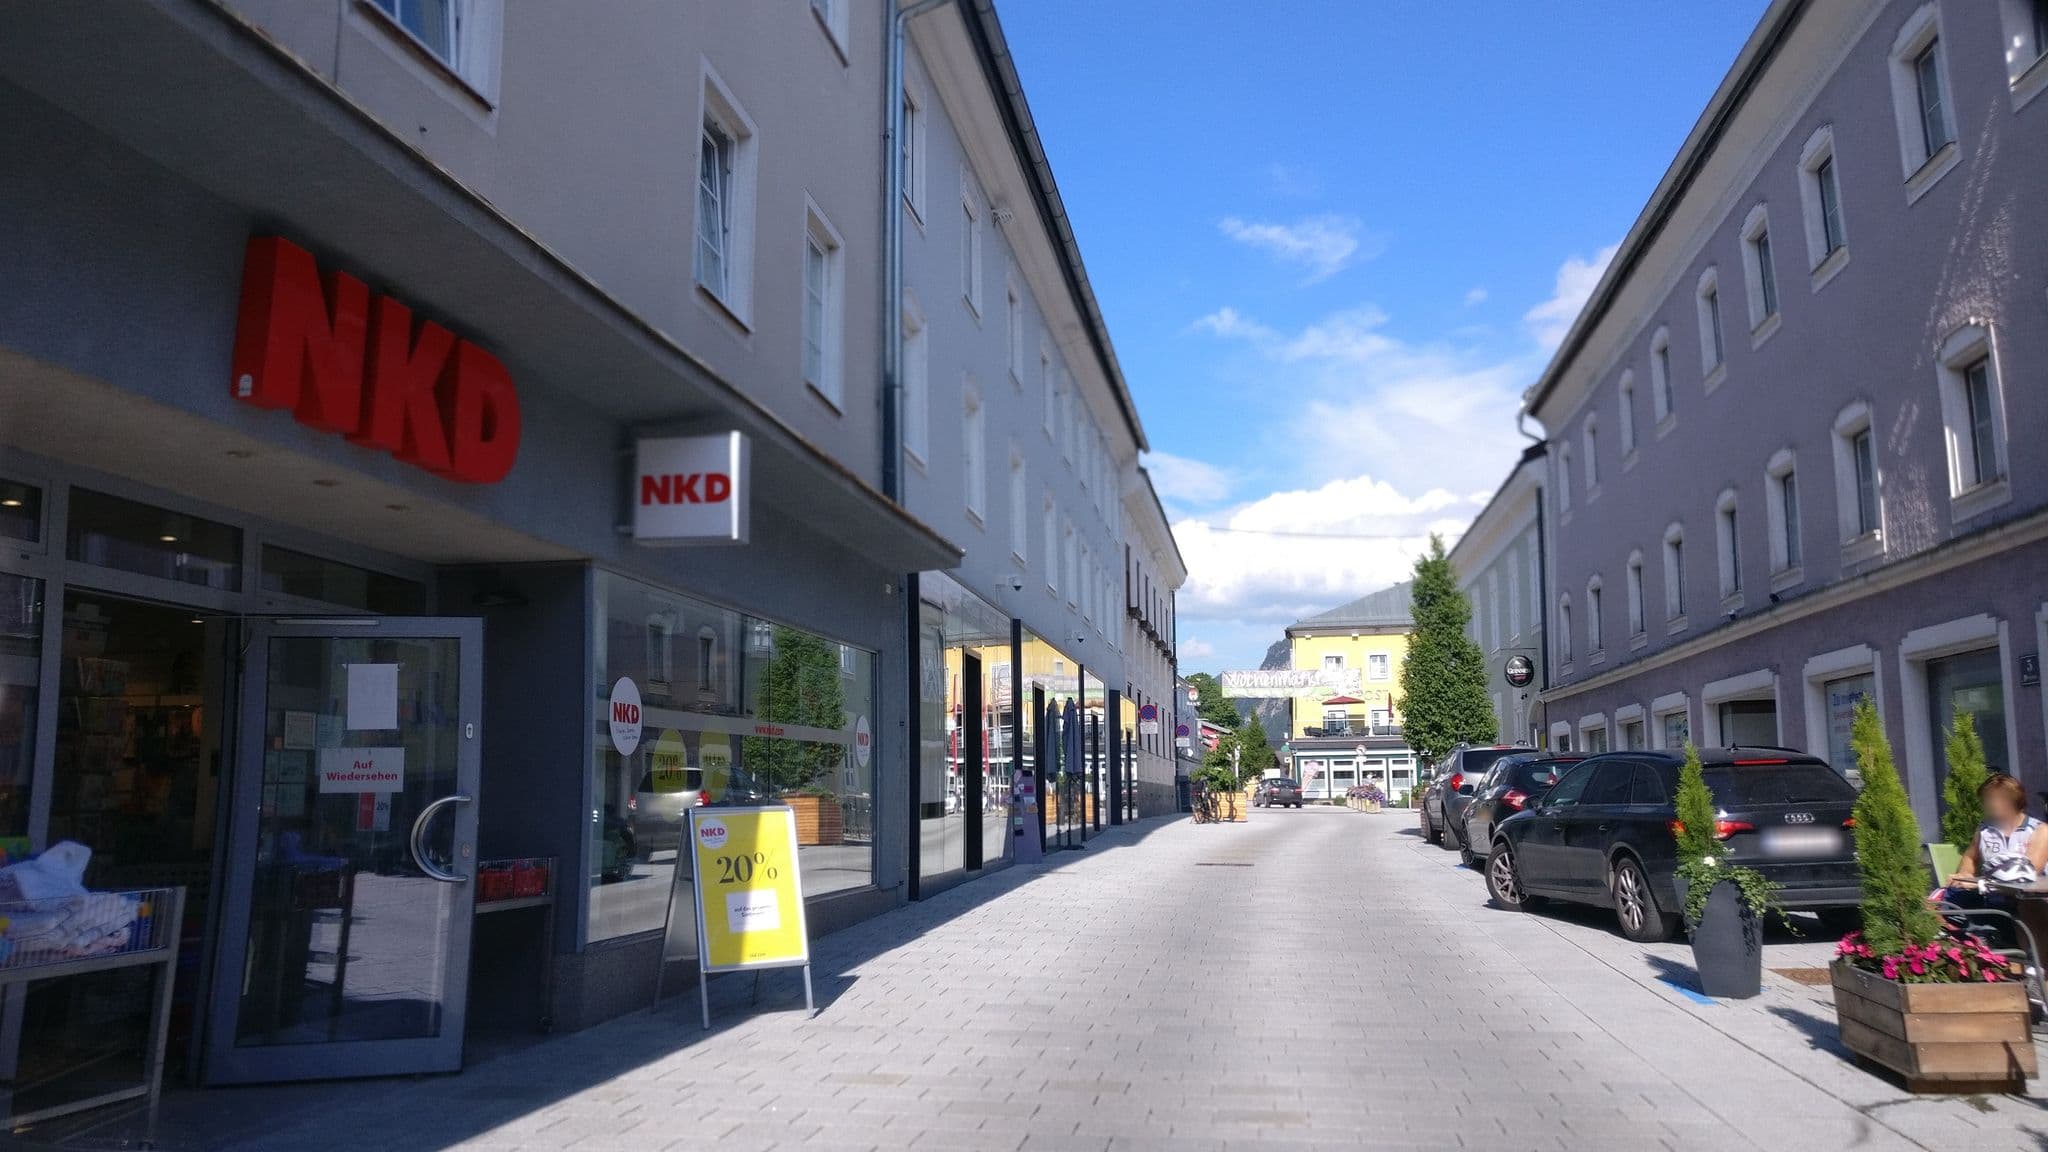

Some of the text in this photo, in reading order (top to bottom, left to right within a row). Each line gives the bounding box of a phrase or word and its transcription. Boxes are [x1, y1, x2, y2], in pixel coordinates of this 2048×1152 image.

[231, 236, 521, 484] NKD
[641, 473, 731, 506] NKD
[613, 702, 639, 724] NKD
[857, 732, 869, 747] NKD
[353, 760, 374, 770] Auf
[326, 771, 398, 782] Wiedersehen
[700, 827, 725, 838] NKD
[716, 849, 778, 884] 20%
